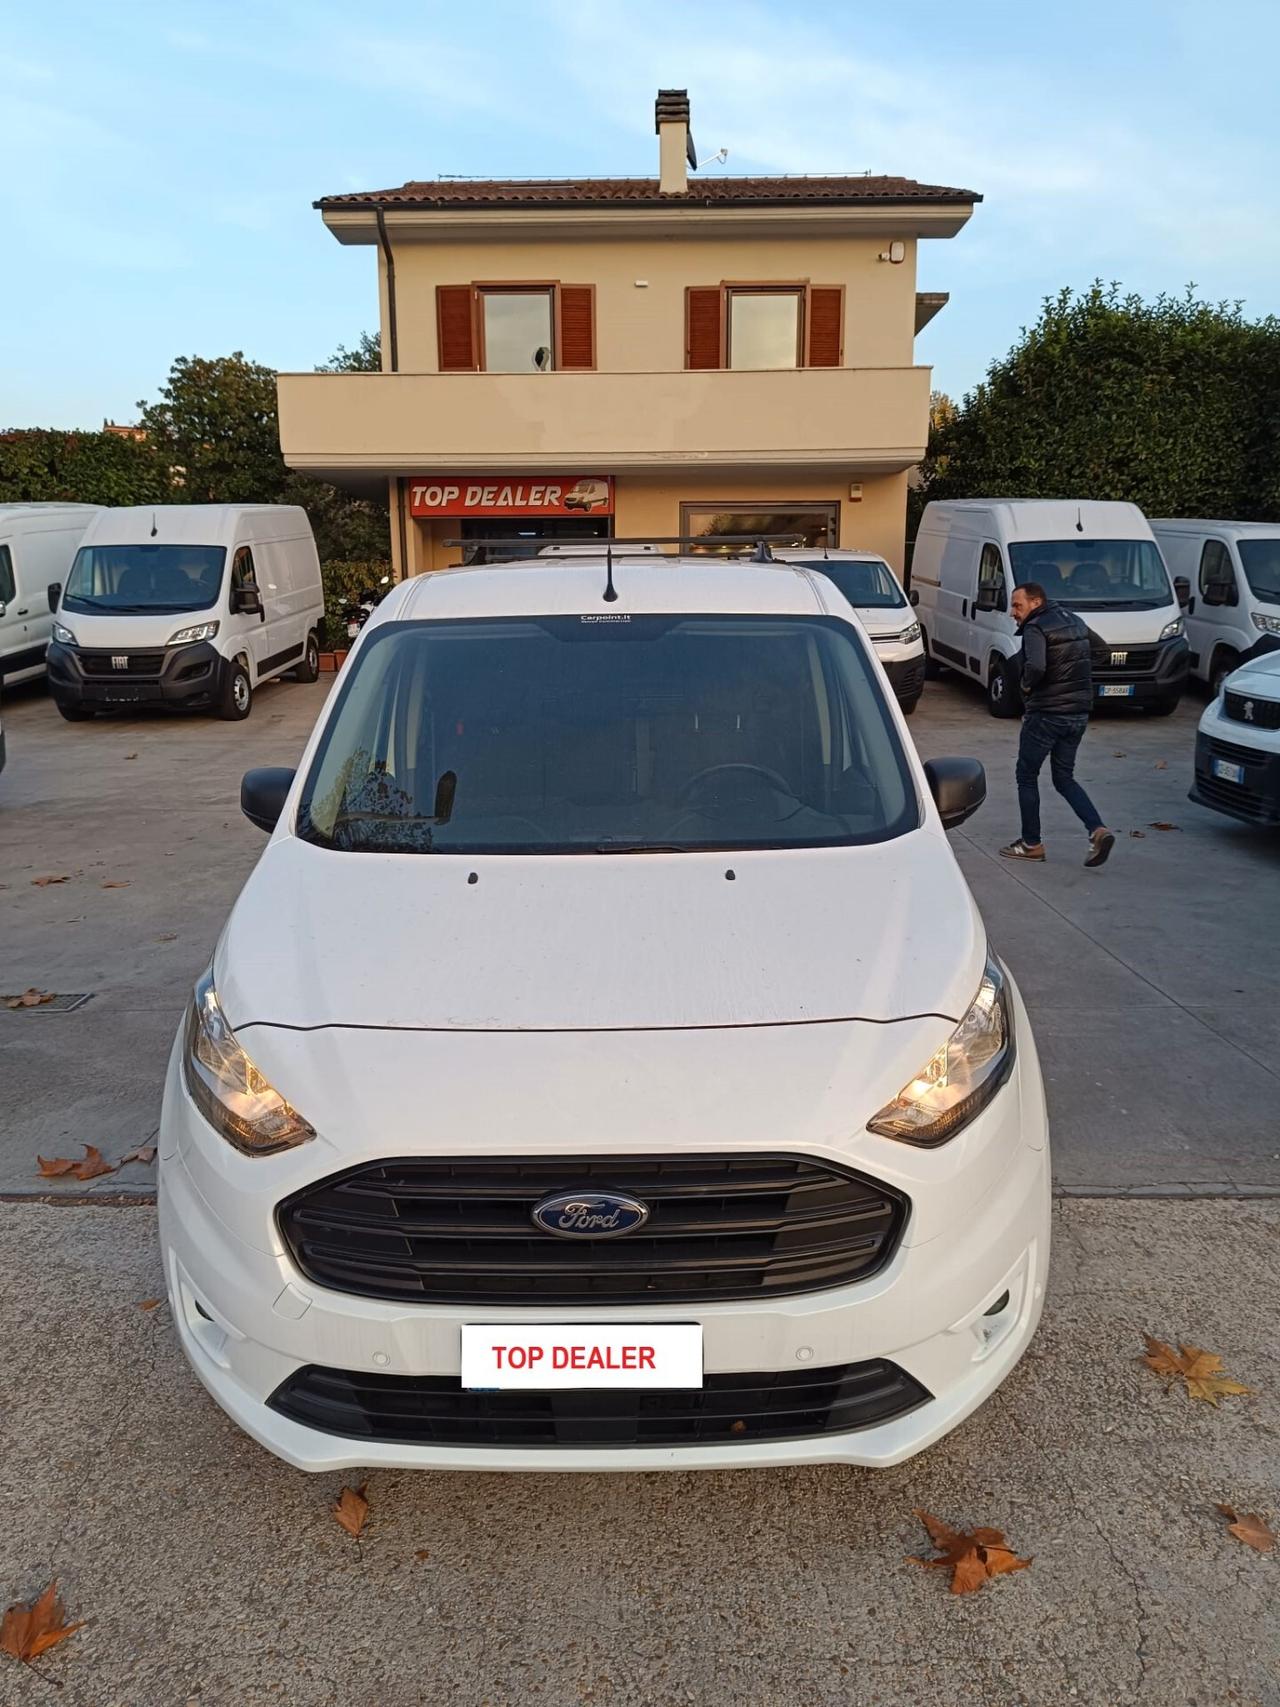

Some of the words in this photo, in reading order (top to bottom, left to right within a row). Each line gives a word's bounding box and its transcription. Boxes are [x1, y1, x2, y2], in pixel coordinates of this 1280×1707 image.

[412, 486, 459, 507] TOP
[464, 485, 562, 507] DEALER
[112, 656, 128, 669] FIAT
[1111, 652, 1128, 665] FIAT
[559, 1202, 620, 1229] Ford
